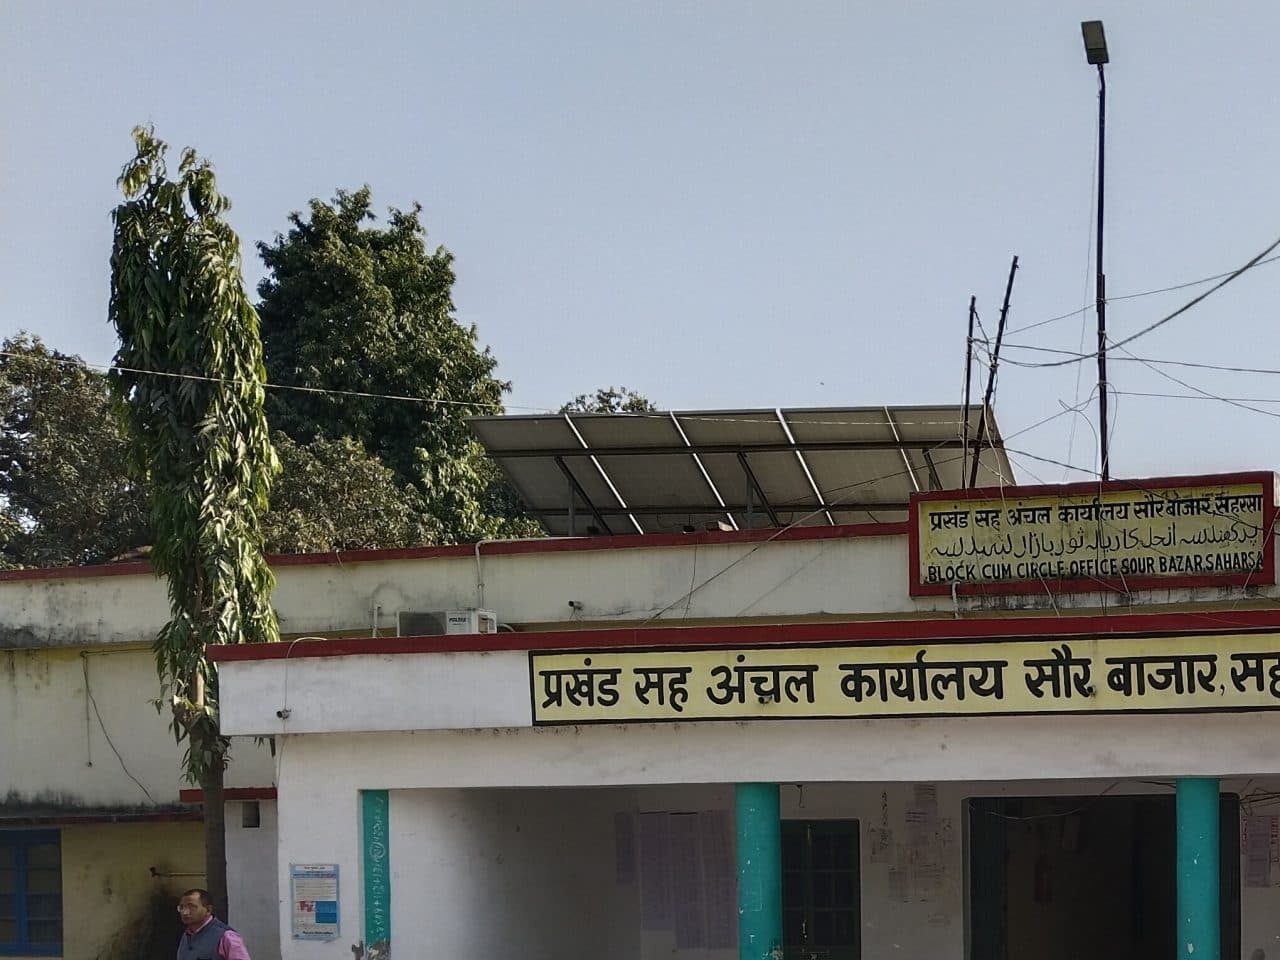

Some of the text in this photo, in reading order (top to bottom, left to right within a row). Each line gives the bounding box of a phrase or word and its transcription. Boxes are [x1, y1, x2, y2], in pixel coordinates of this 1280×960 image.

[929, 505, 969, 531] प्रखंड
[975, 509, 1001, 530] सह
[1007, 502, 1052, 526] अंचल
[1059, 496, 1130, 523] कार्यालय
[1216, 495, 1263, 516] सहरसा
[928, 564, 977, 582] BLOCK
[982, 564, 1012, 580] CUM
[1017, 561, 1064, 578] CIRCLE
[1070, 558, 1117, 576] OFFICE
[1121, 557, 1156, 574] SOUR
[1206, 551, 1263, 570] SAHARSA
[539, 658, 622, 709] प्रखंड
[633, 667, 692, 712] सह
[705, 655, 818, 705] अंचल
[839, 650, 1008, 703] कार्यालय
[1024, 645, 1092, 698] सौर
